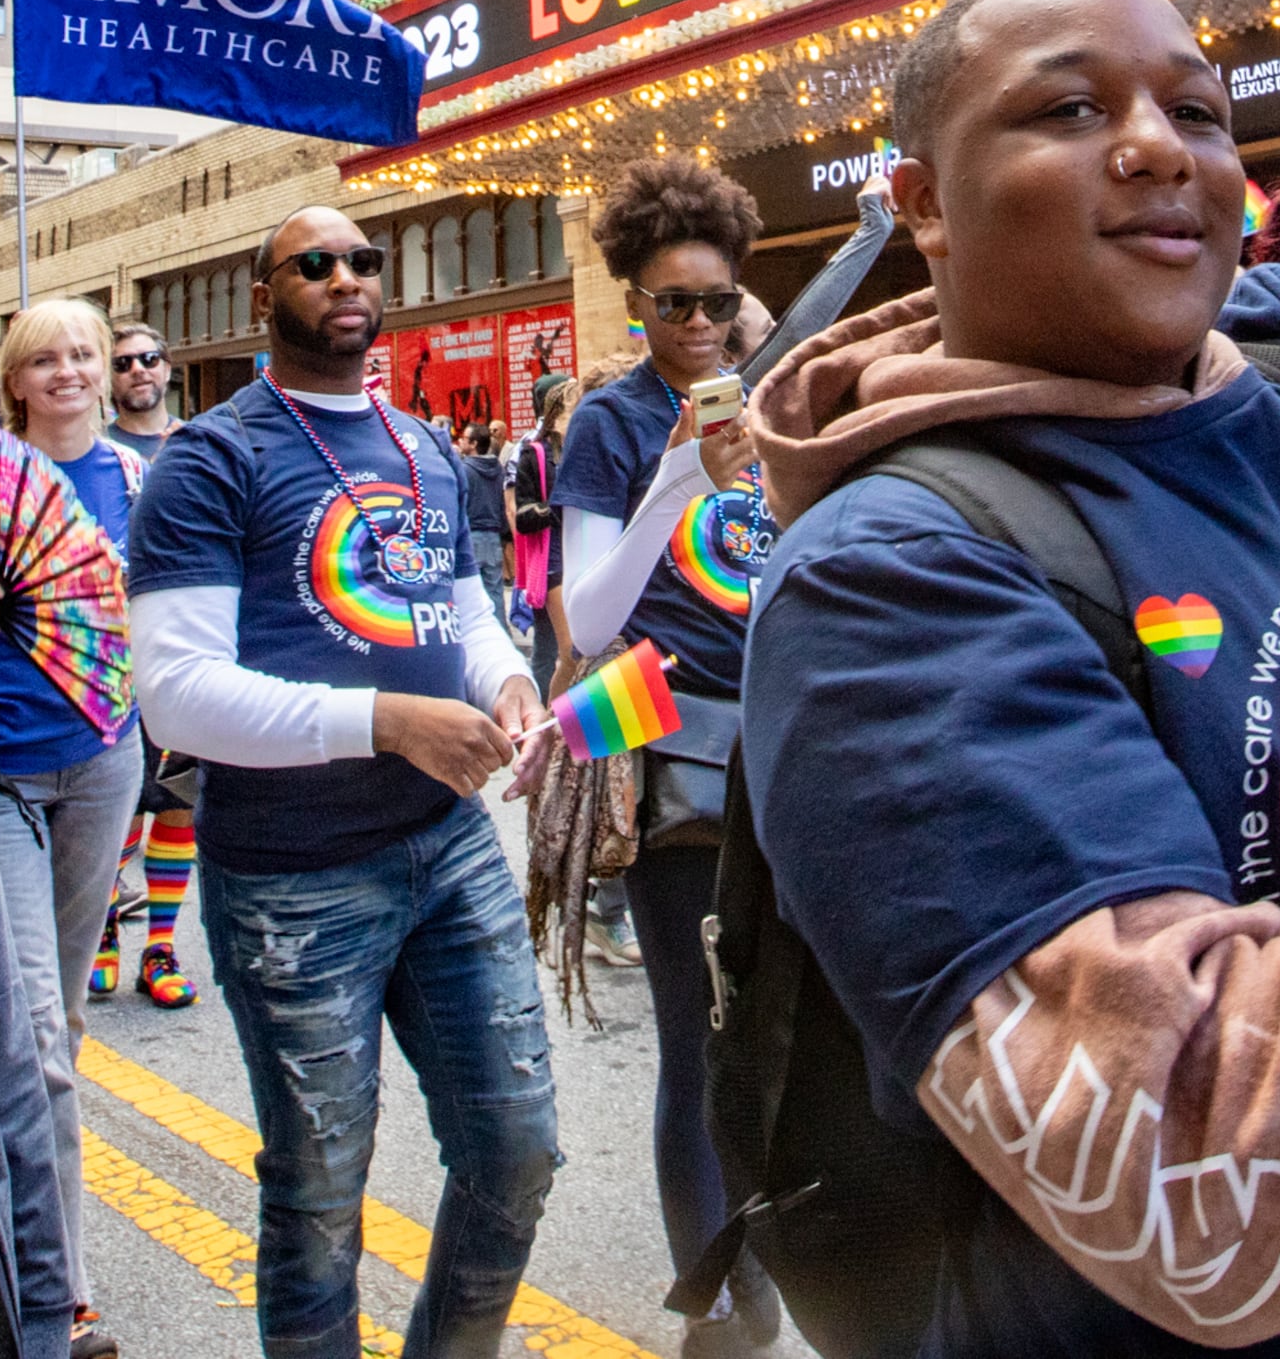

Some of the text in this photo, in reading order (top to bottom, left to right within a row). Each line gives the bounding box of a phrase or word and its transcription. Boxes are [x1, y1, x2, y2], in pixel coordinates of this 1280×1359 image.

[61, 14, 383, 86] HEALTHCARE
[1231, 77, 1276, 100] LEXUS
[333, 471, 383, 494] povide.
[302, 505, 324, 538] care
[293, 541, 310, 567] the
[297, 582, 325, 615] pride
[317, 613, 343, 641] take
[347, 635, 372, 655] We
[1243, 694, 1273, 797] care
[1238, 811, 1274, 885] the
